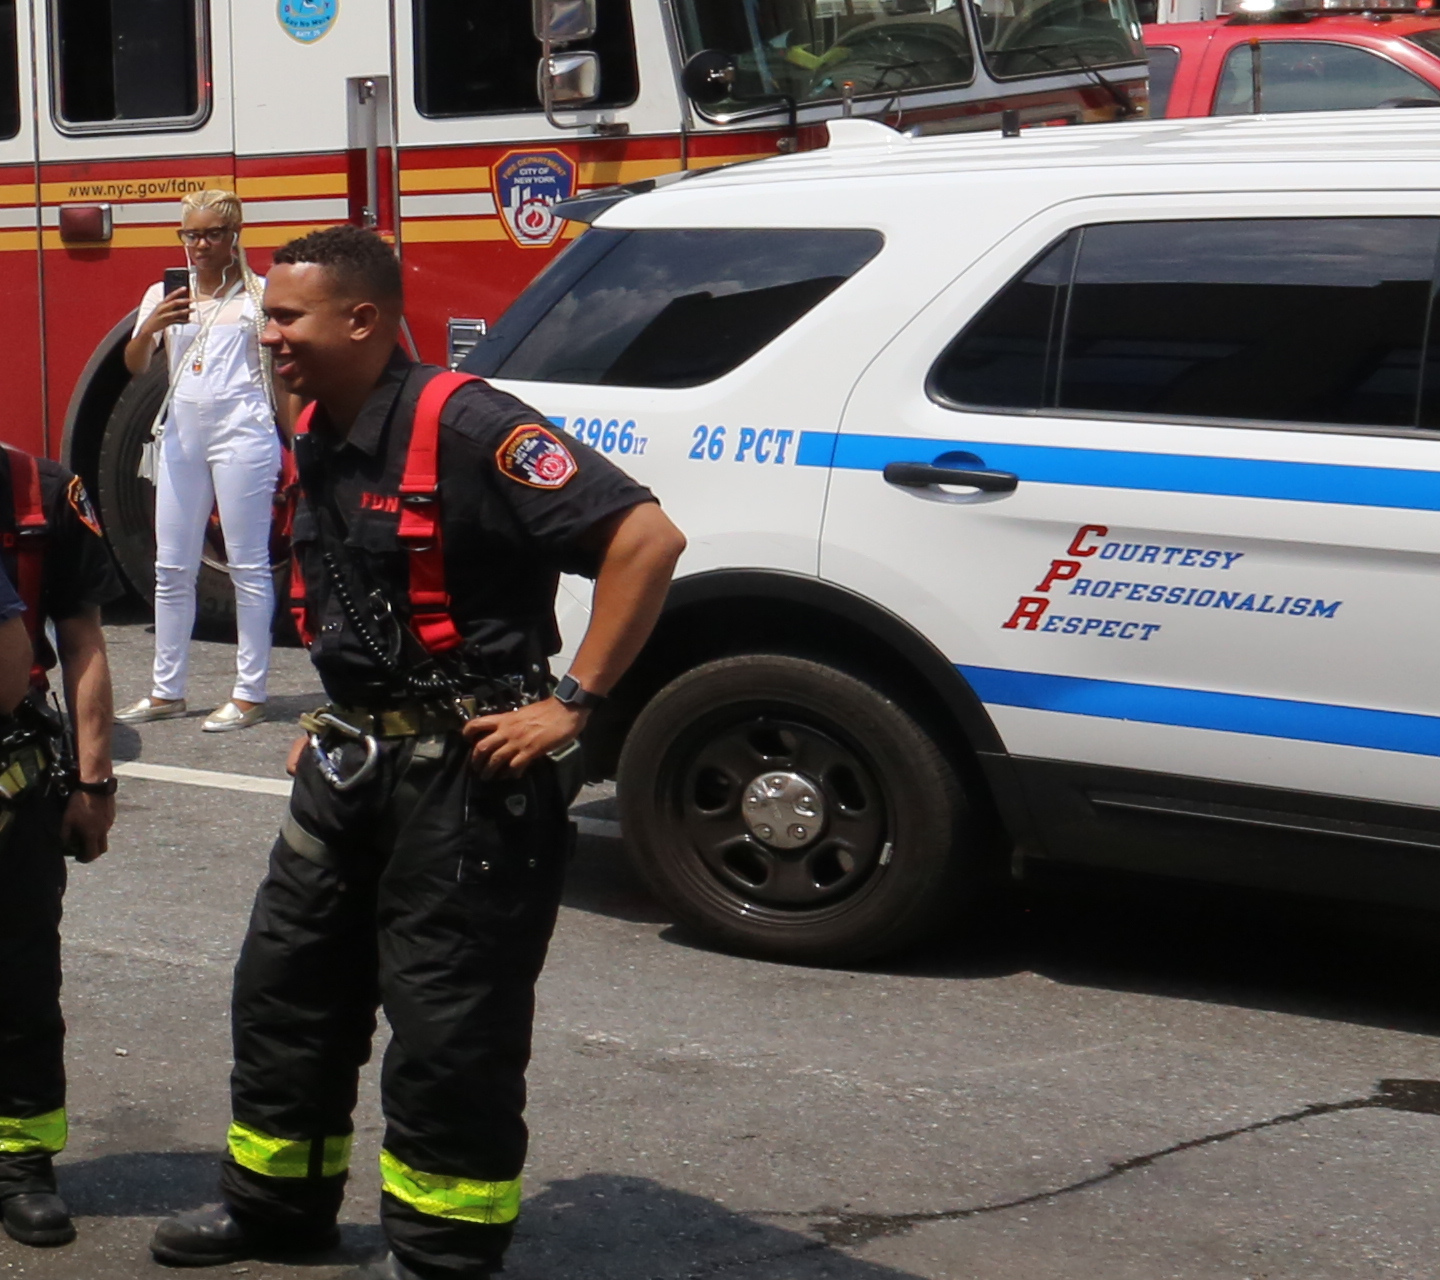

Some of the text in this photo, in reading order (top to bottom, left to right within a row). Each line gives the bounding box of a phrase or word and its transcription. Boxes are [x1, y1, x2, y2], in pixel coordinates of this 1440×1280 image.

[68, 179, 207, 198] www.nyc.gov/fdny
[513, 175, 557, 185] NEW YORK
[519, 166, 550, 177] CITY OF
[571, 417, 637, 454] 3966
[688, 424, 795, 465] 26 PCT
[361, 491, 399, 514] FDN
[1066, 523, 1245, 570] COURTESY
[1033, 559, 1343, 619] PROFESSIONALISM
[1001, 596, 1161, 642] RESPECT
